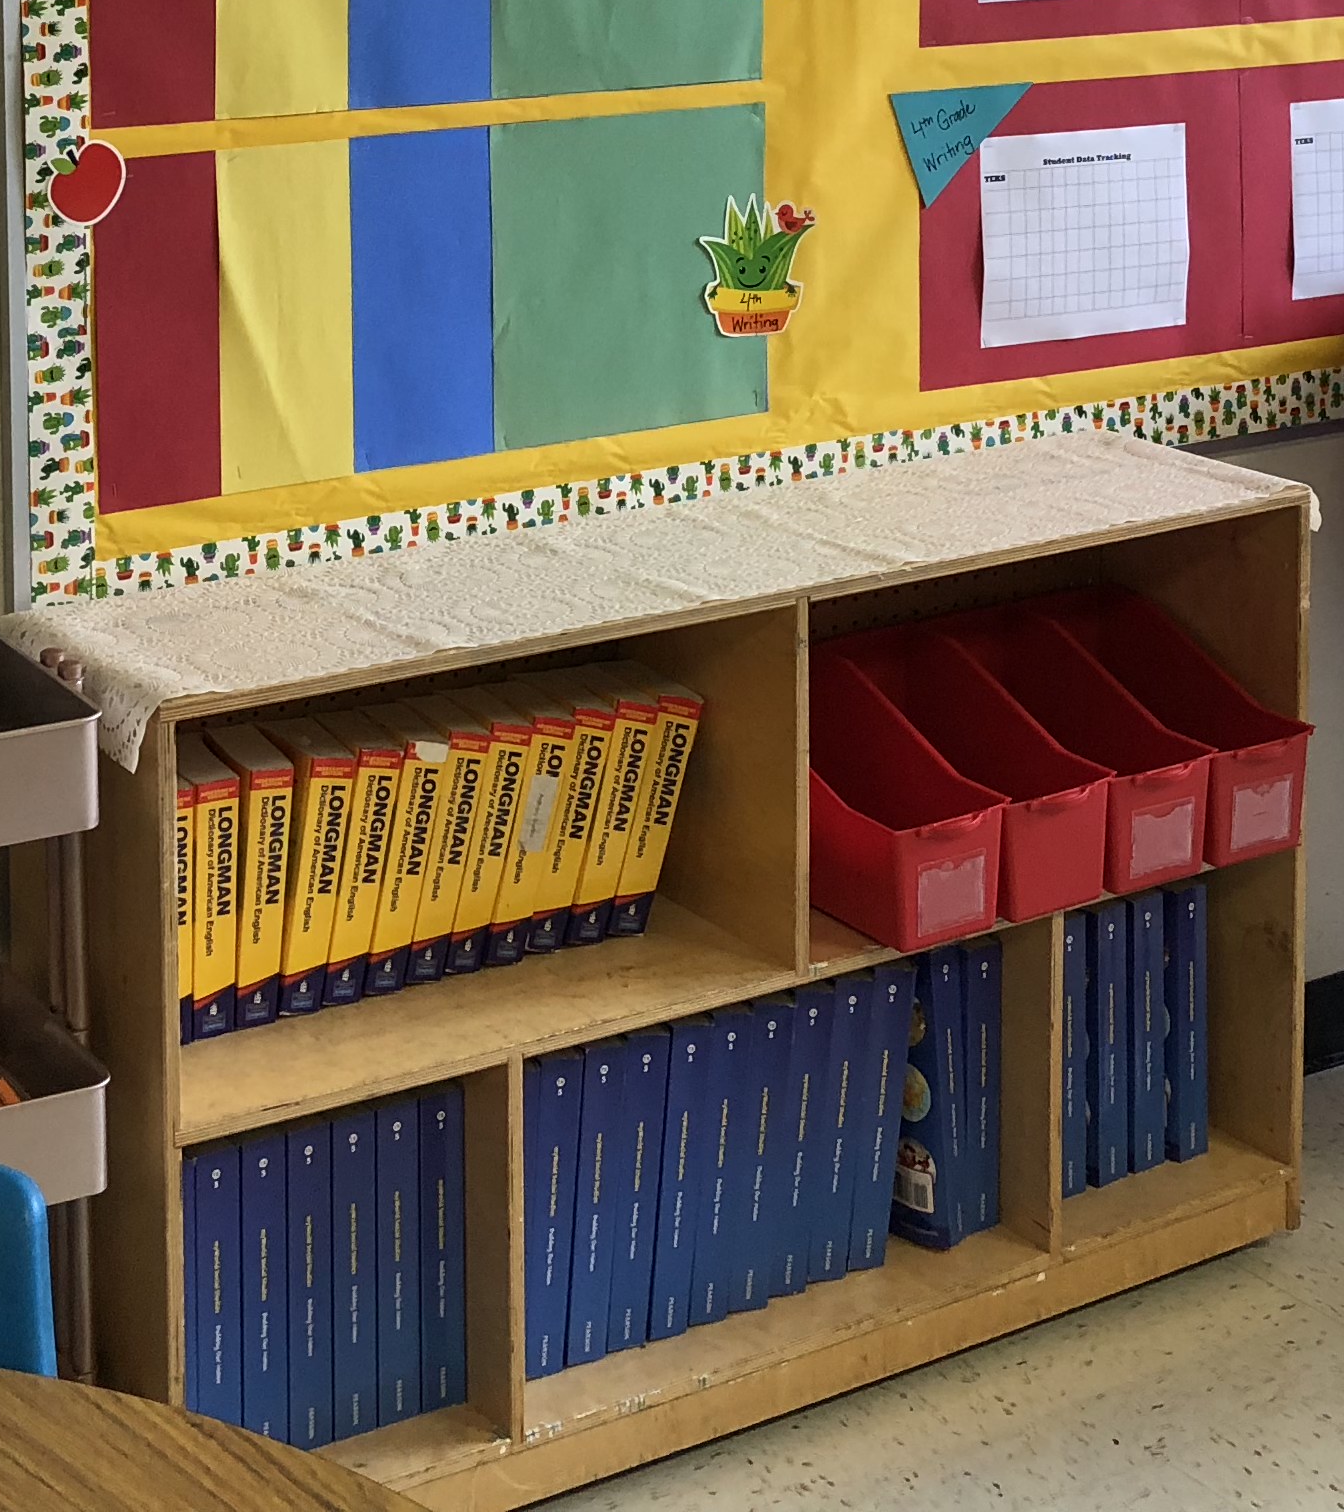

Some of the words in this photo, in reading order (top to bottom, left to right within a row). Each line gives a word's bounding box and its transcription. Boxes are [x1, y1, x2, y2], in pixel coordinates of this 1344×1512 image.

[910, 115, 934, 138] 4th
[936, 100, 976, 130] Grade
[923, 135, 976, 172] Writing
[1042, 156, 1075, 166] Student
[1076, 155, 1095, 164] Data
[1096, 153, 1132, 162] Tracking
[731, 312, 778, 332] Writing
[740, 293, 762, 312] 4th
[614, 727, 632, 773] Dictionary
[448, 757, 465, 806] Dictionary
[569, 735, 604, 840] LONGMAN
[613, 774, 621, 785] of
[613, 728, 648, 832] LONGMAN
[653, 722, 690, 826] LONGMAN
[256, 796, 270, 846] Dictionary
[316, 785, 329, 835] Dictionary
[406, 768, 439, 876] LONGMAN
[447, 807, 455, 818] of
[448, 758, 481, 865] LONGMAN
[488, 751, 522, 858] LONGMAN
[603, 785, 619, 829] American
[205, 808, 216, 858] Dictionary
[265, 794, 287, 905] LONGMAN
[313, 835, 322, 846] of
[317, 785, 346, 894] LONGMAN
[362, 775, 392, 884] LONGMAN
[438, 818, 453, 864] American
[596, 831, 610, 866] English
[216, 806, 233, 916] LONGMAN
[258, 848, 265, 858] of
[307, 847, 321, 894] American
[205, 873, 215, 918] American
[255, 859, 266, 906] American
[430, 866, 444, 902] English
[251, 908, 263, 944] English
[302, 897, 314, 933] English
[204, 920, 214, 957] English
